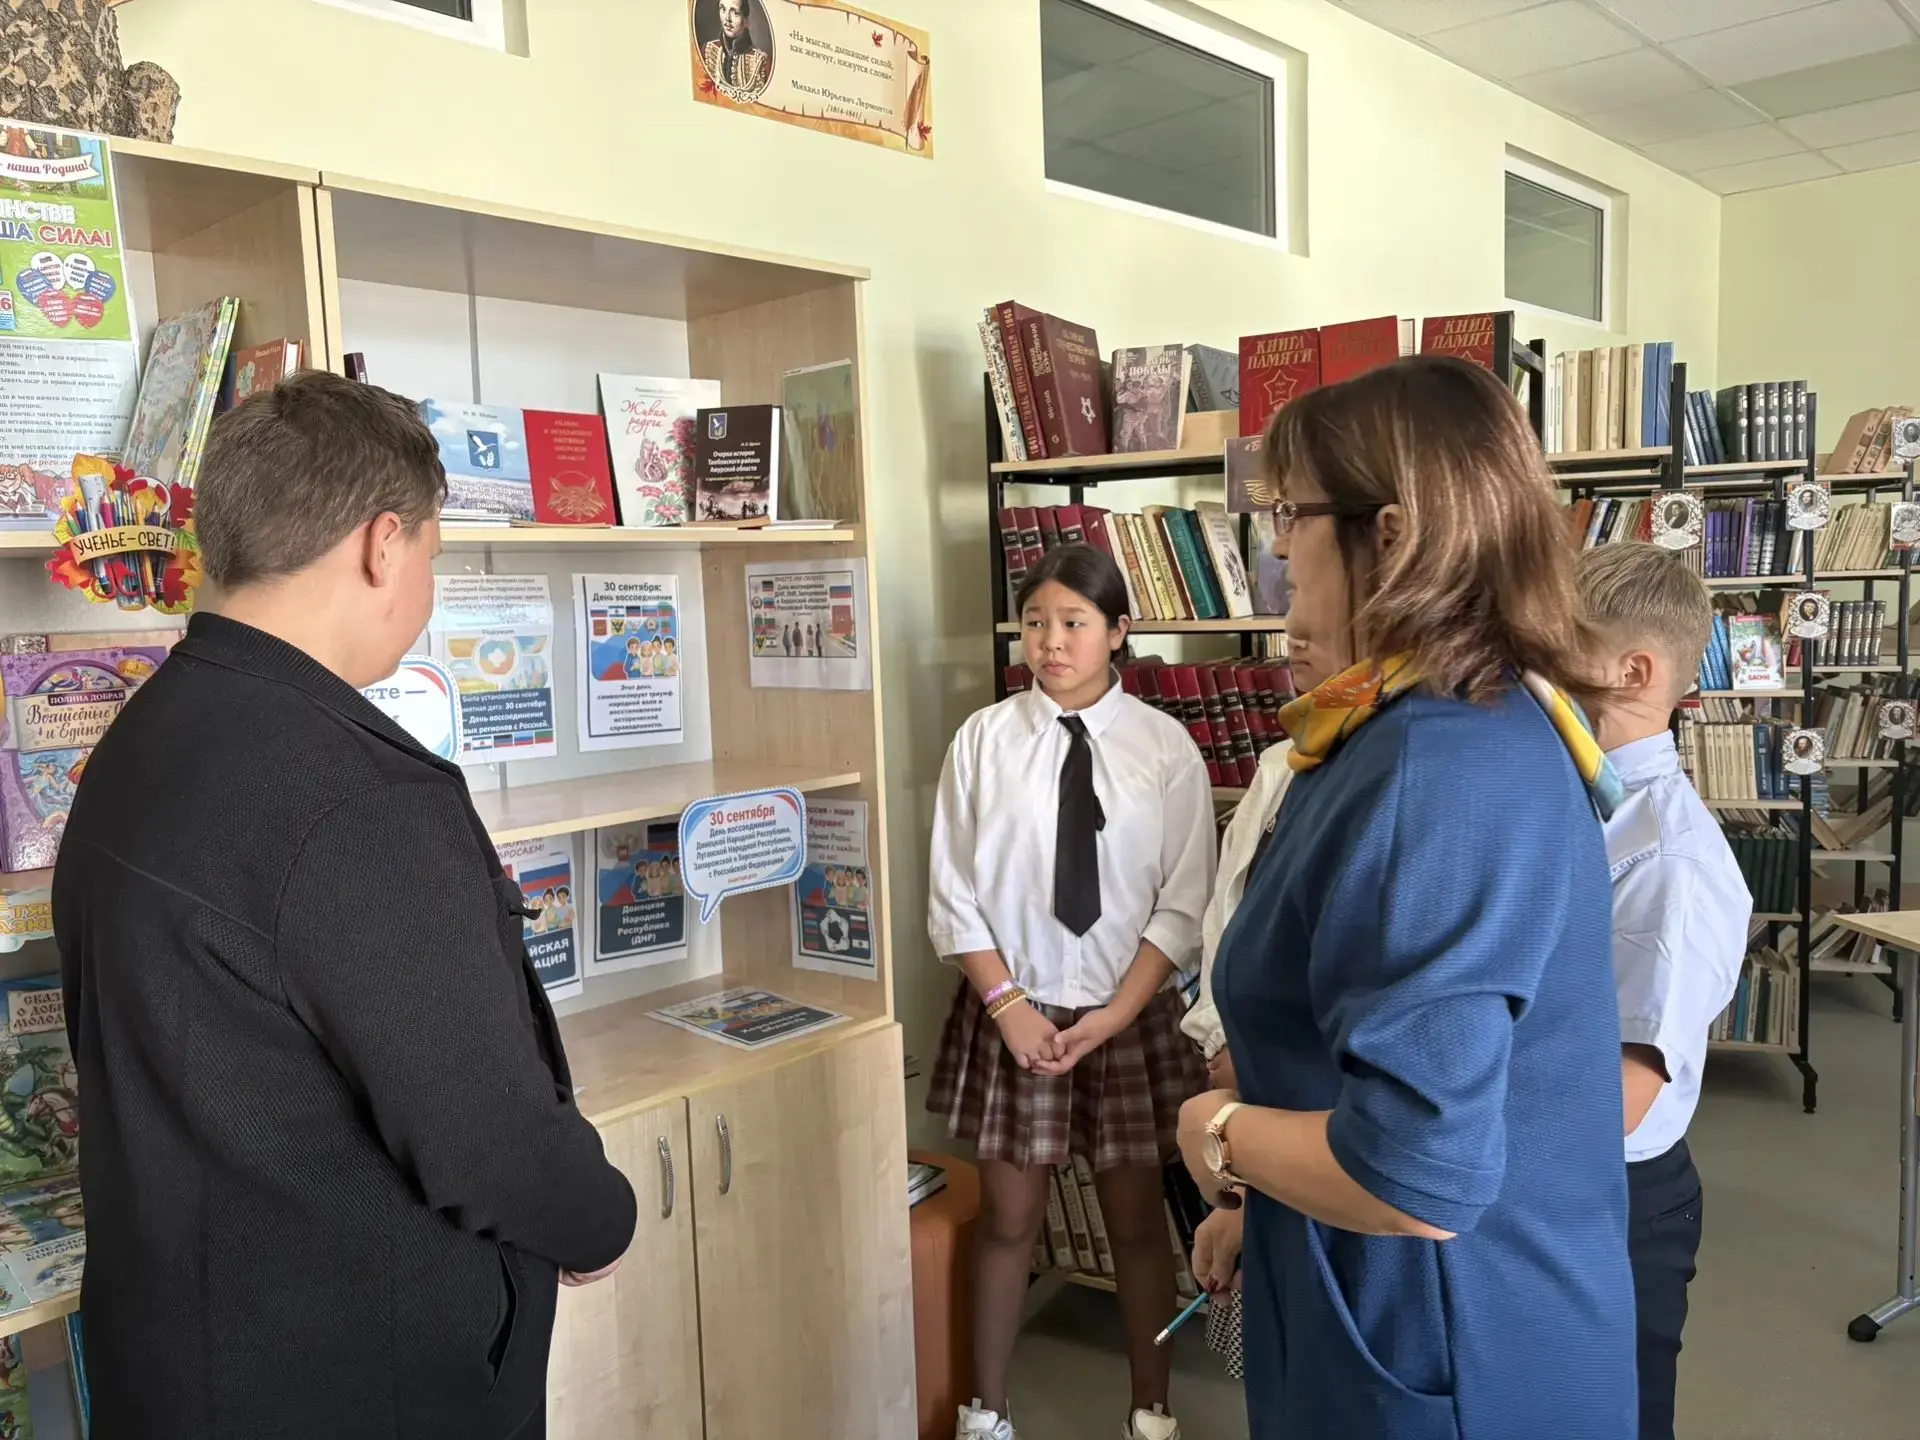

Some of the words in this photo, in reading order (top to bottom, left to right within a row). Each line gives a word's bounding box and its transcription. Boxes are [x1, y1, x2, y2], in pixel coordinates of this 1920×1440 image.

[789, 44, 804, 56] как
[805, 49, 836, 66] жемчуг,
[837, 57, 869, 75] нижутся
[805, 36, 833, 50] мысли,
[834, 43, 870, 61] дышащие
[870, 54, 894, 70] силой,
[791, 79, 820, 96] Михаил
[821, 87, 855, 106] Юрьевич
[856, 97, 893, 115] Лермонтов
[7, 162, 41, 174] наша
[43, 160, 89, 176] Родина!
[39, 224, 113, 248] СИЛА!
[1256, 335, 1305, 355] КНИГА
[1431, 332, 1494, 350] ПАМЯТ
[1247, 348, 1313, 370] ПАМЯТИ
[620, 399, 668, 418] Живая
[625, 416, 663, 437] радуга
[713, 451, 732, 459] Очерки
[733, 450, 755, 458] истории
[741, 458, 760, 466] района
[710, 466, 735, 474] Амурской
[603, 582, 616, 591] 30
[618, 581, 662, 593] сентября:
[592, 593, 614, 602] День
[615, 594, 673, 602] воссоединения
[51, 694, 88, 704] ПОЛИНА
[90, 691, 125, 702] ДОБРАЯ
[364, 687, 400, 700] сте
[481, 693, 520, 701] установлена
[648, 690, 673, 699] триумф
[505, 702, 514, 710] 30
[515, 700, 547, 710] сентября
[608, 700, 642, 708] народной
[26, 703, 111, 726] Волшебные
[469, 716, 488, 724] День
[489, 711, 544, 722] воссоединения
[613, 714, 659, 723] исторической
[478, 724, 512, 735] регионов
[519, 720, 550, 730] Россией.
[710, 811, 724, 826] 30
[727, 804, 776, 822] сентября
[806, 806, 827, 814] оссия
[710, 828, 726, 838] День
[727, 820, 776, 834] воссоединения
[696, 840, 726, 850] Донецкой
[727, 831, 755, 843] Народной
[756, 827, 791, 837] Республики,
[696, 847, 727, 861] Луганской
[728, 842, 756, 853] Народной
[757, 836, 792, 848] Республики,
[694, 857, 732, 870] Запорожской
[738, 848, 771, 860] Херсонской
[713, 864, 747, 877] Российской
[748, 855, 785, 868] Федерацией
[622, 901, 666, 914] Донецкая
[622, 912, 665, 925] Народная
[617, 921, 670, 936] Республика
[631, 934, 656, 946] (ДНР)
[534, 952, 567, 969] АЦИЯ
